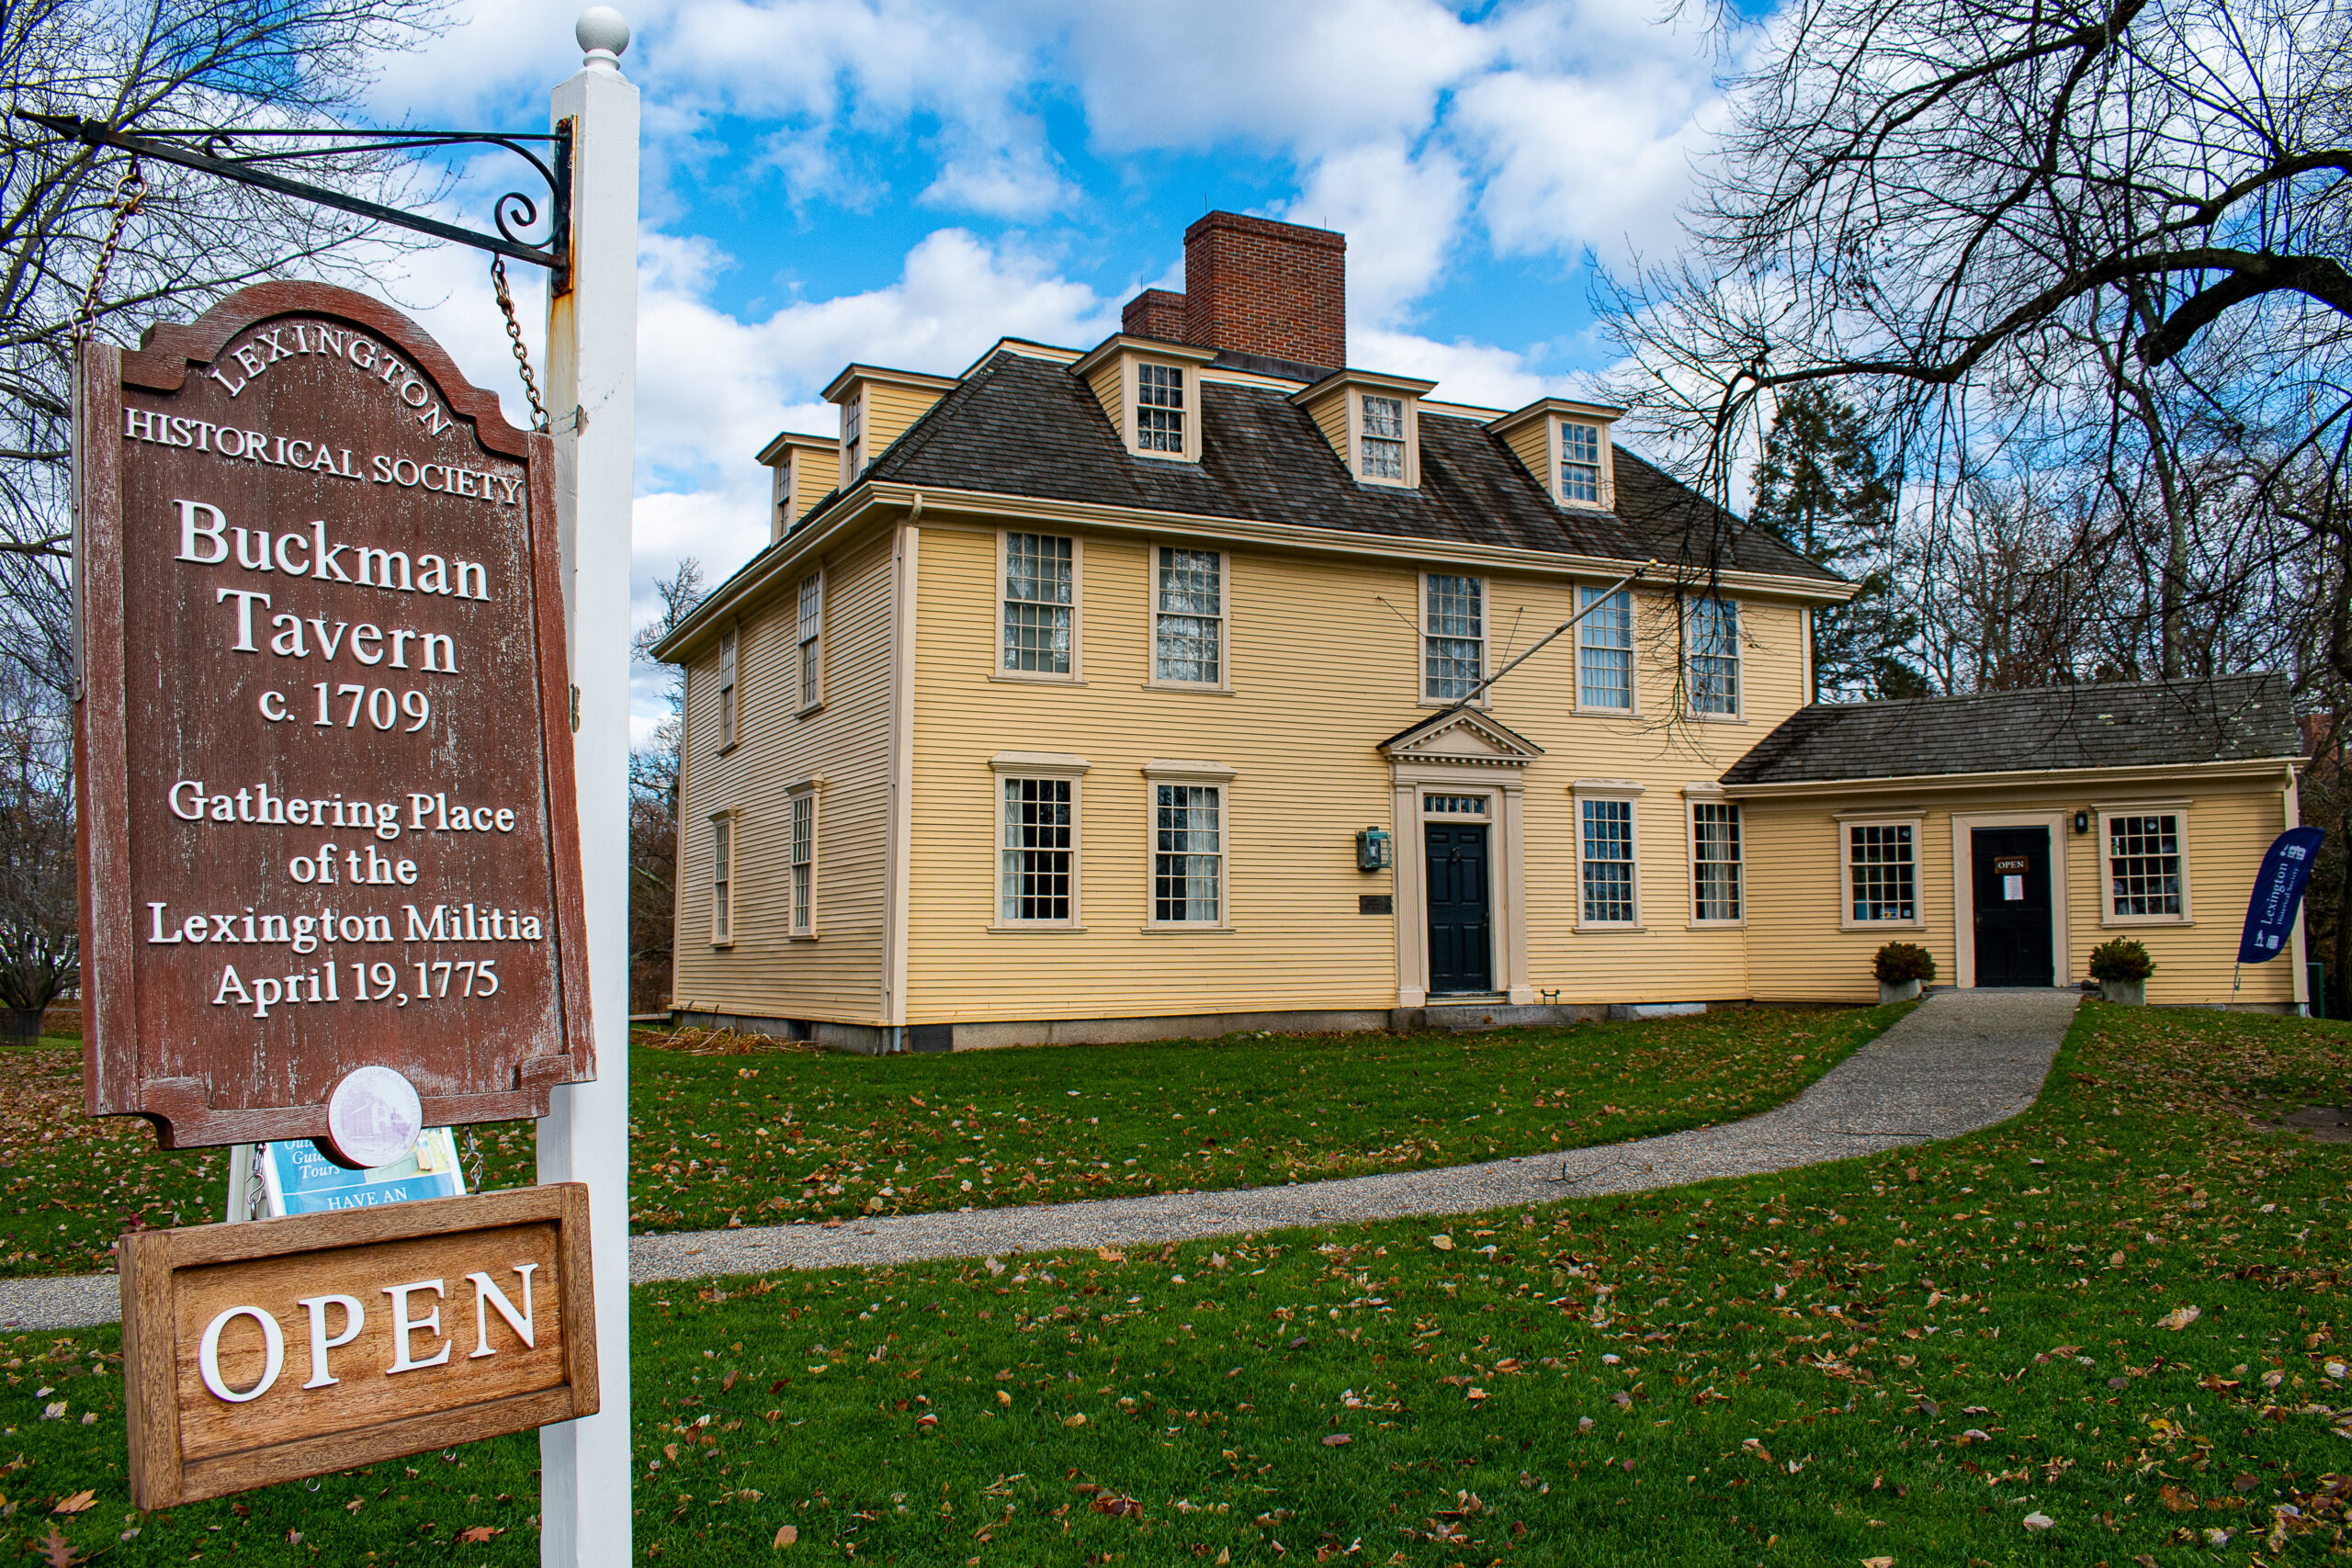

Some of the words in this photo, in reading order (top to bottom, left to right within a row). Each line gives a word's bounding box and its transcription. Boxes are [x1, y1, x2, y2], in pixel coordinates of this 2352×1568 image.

[209, 324, 453, 437] LEXINGTON
[124, 407, 362, 481] HISTORICAL
[372, 455, 524, 505] SOCIETY
[173, 499, 492, 603] Buckman
[216, 588, 459, 674] Tavern
[259, 691, 295, 722] c.
[312, 682, 430, 733] 1709
[167, 780, 400, 840] Gathering
[406, 793, 514, 832] Place
[288, 843, 338, 885] of
[345, 845, 418, 886] the
[2260, 863, 2288, 925] Lexington
[146, 902, 393, 953] Lexington
[401, 903, 542, 942] Militia
[212, 960, 339, 1018] April
[299, 1165, 341, 1179] Tours
[327, 1191, 378, 1210] HAVE
[383, 1187, 408, 1201] AN
[198, 1263, 539, 1403] OPEN
